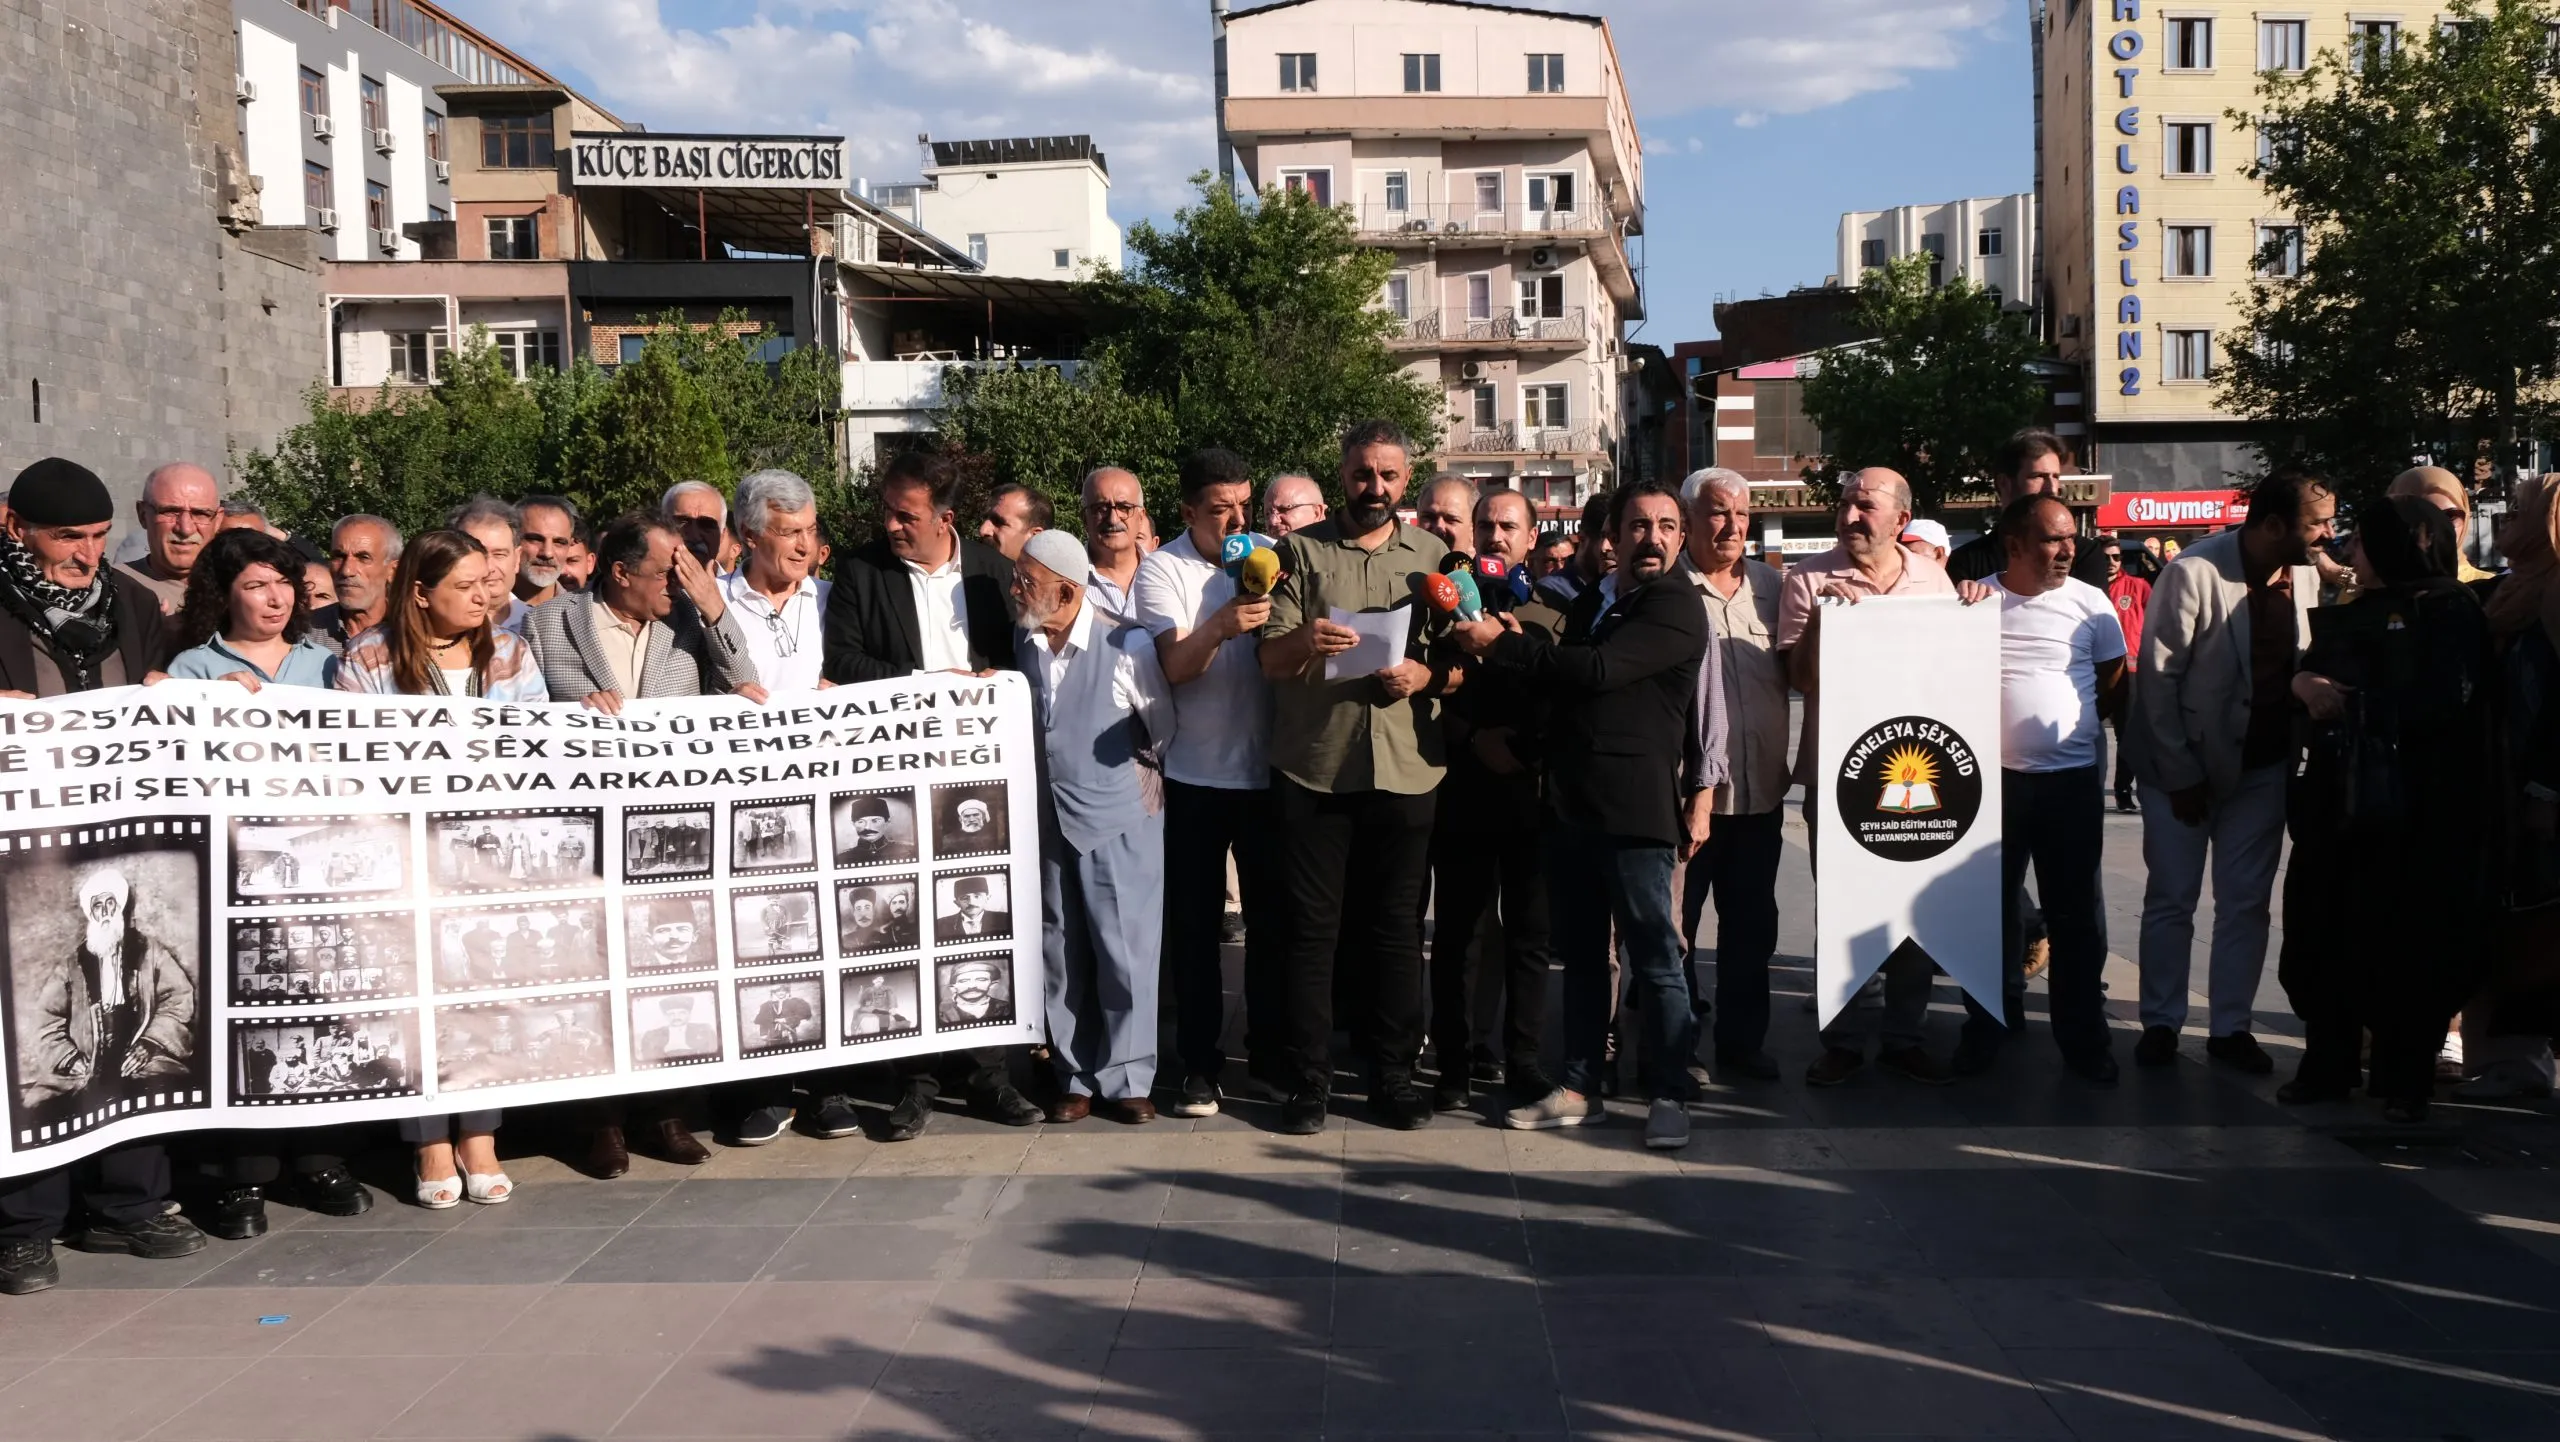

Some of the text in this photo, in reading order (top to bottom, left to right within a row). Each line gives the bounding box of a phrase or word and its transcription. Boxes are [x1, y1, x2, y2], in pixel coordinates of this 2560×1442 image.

[577, 139, 843, 181] KÜÇE BAŞI CİĞERCİSİ
[2140, 498, 2225, 523] Duymer
[1487, 562, 1498, 574] 8
[0, 684, 997, 735] 1925'AN KOMELEYA ŞÊX SEÎD Û RÊHEVALÊN WÎ
[203, 740, 452, 763] KOMELEYA
[466, 734, 549, 763] ŞÊX
[563, 738, 674, 759] SEÎDÎ
[687, 739, 714, 755] Û
[728, 716, 943, 754] EMBAZANÊ
[956, 716, 998, 737] EY
[1844, 721, 1974, 780] KOMELEYA ŞÊX SEÎD
[134, 776, 250, 801] ŞEYH
[264, 774, 365, 798] SAİD
[378, 776, 432, 796] VE
[447, 772, 557, 794] DAVA
[568, 760, 840, 791] ARKADAŞLARI
[852, 743, 1002, 775] DERNEĞİ
[1860, 818, 1958, 832] ŞEYH SAİD EĞİTİM KÜLTÜR
[1864, 831, 1954, 843] VE DAYANIŞMA DERNEĞİ
